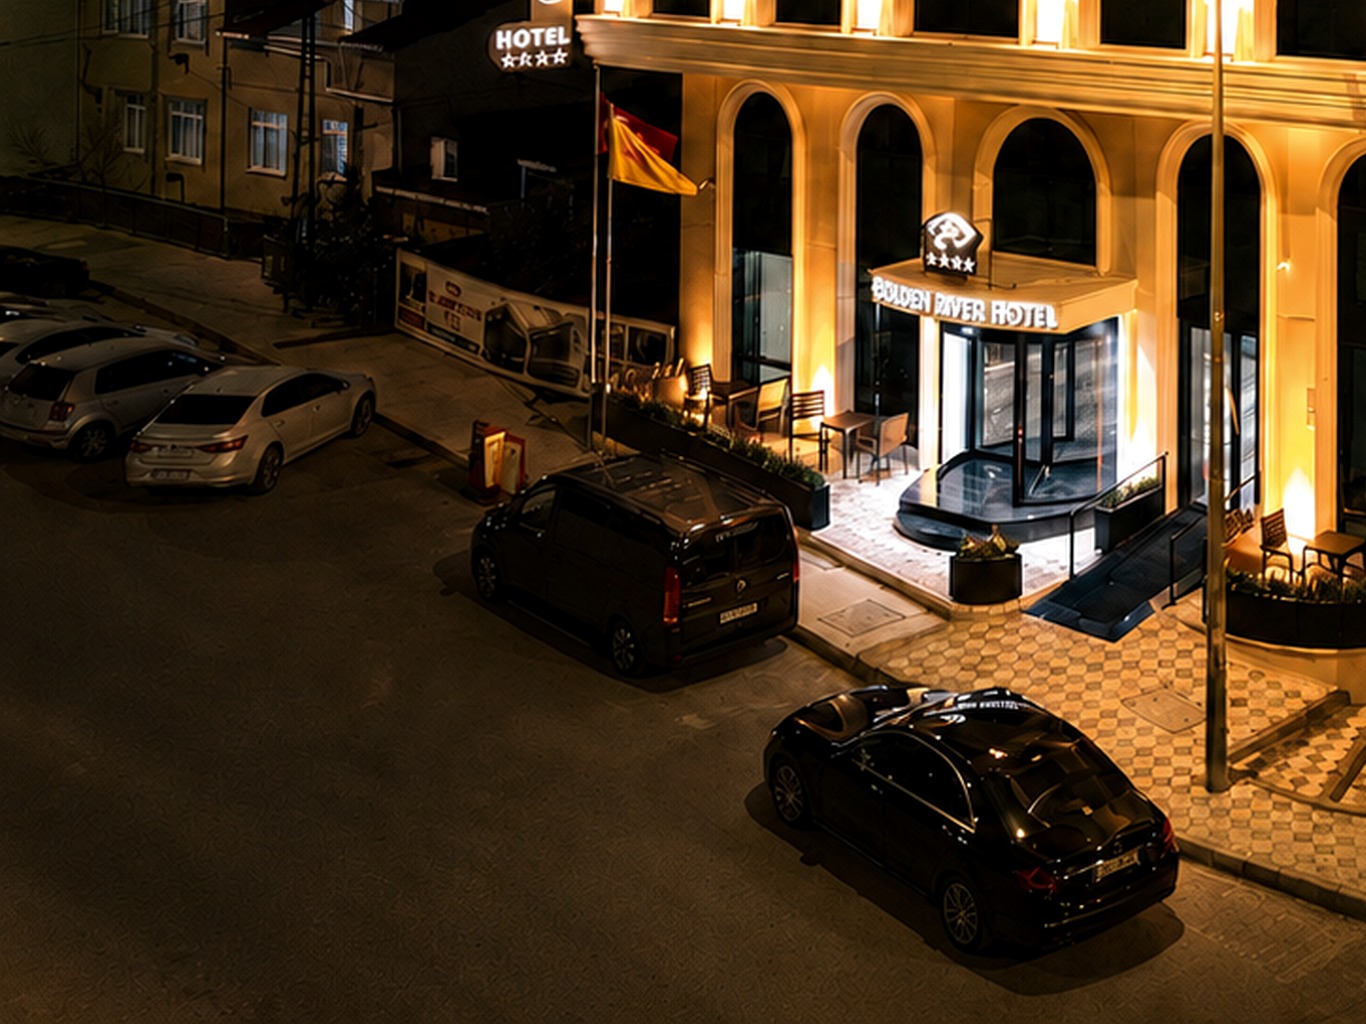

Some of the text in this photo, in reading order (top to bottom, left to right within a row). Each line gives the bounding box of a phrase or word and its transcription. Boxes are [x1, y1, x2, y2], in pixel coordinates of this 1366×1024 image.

[495, 26, 572, 51] HOTEL
[871, 275, 1059, 330] GOLDEN RIVER HOTEL
